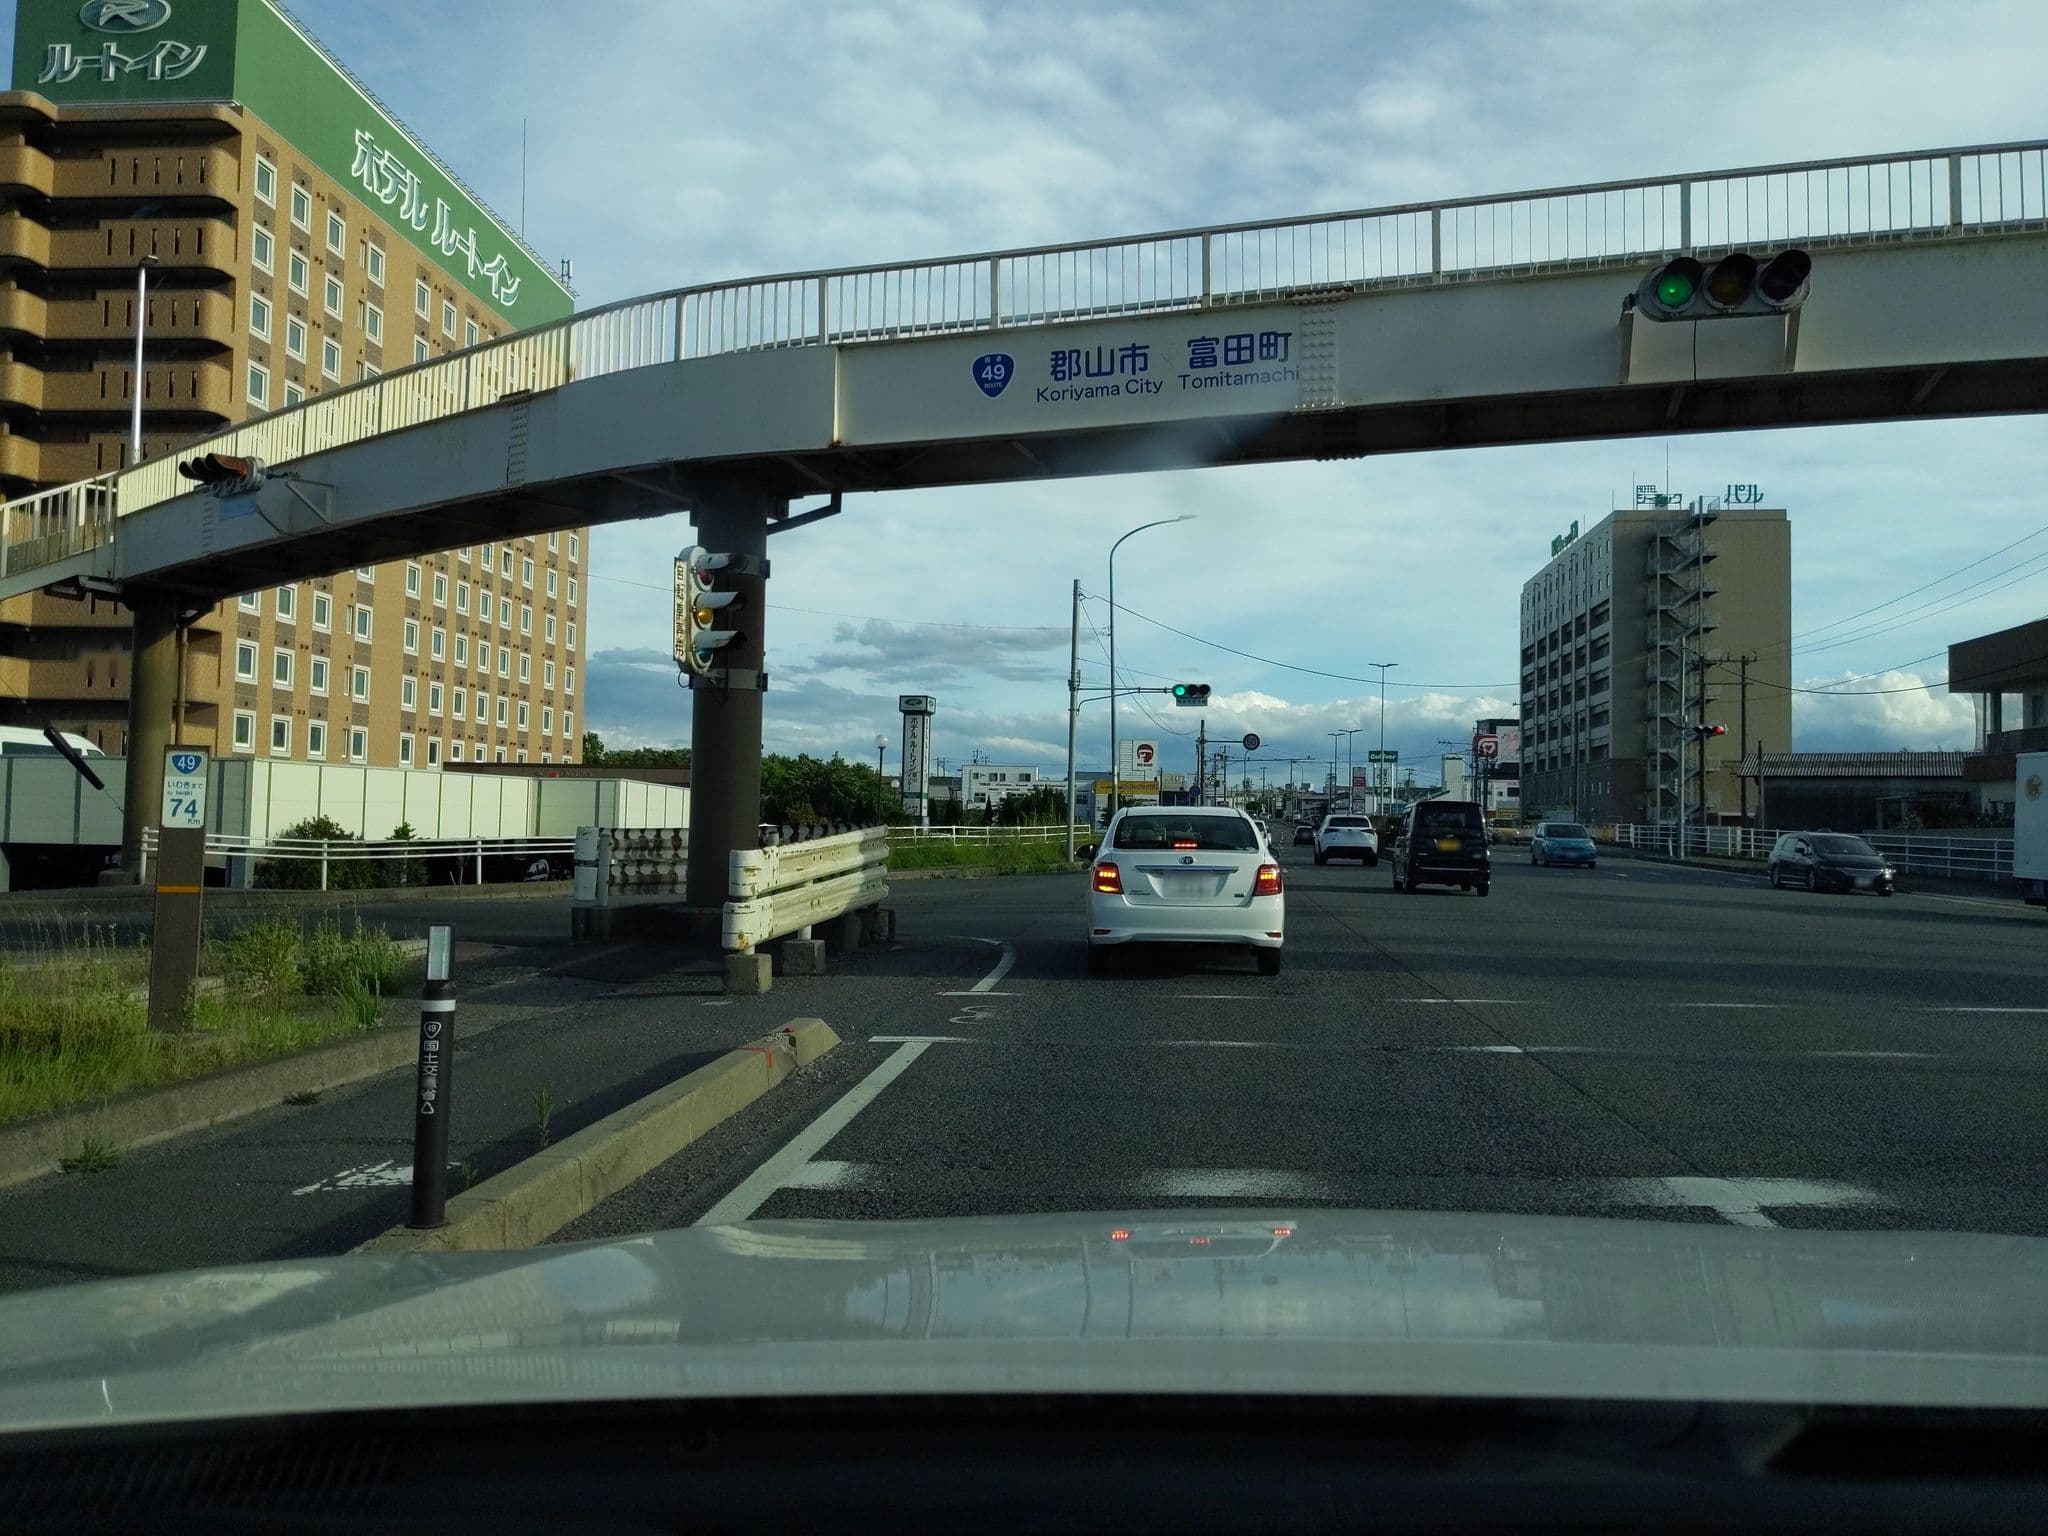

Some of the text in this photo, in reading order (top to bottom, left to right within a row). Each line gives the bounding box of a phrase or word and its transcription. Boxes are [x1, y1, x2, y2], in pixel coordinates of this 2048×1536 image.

[38, 41, 208, 84] ルートイン
[352, 128, 522, 306] ホテル ルートイン
[1050, 331, 1293, 381] 郡山市 富田町
[981, 364, 1005, 381] 49
[1037, 364, 1300, 403] Koriyama City Tomitamachi
[1636, 484, 1656, 493] HOTEL
[1724, 484, 1764, 503] パル
[178, 756, 195, 770] 49
[170, 799, 197, 817] 74
[427, 1024, 437, 1033] 49
[421, 1041, 439, 1100] 国土交省
